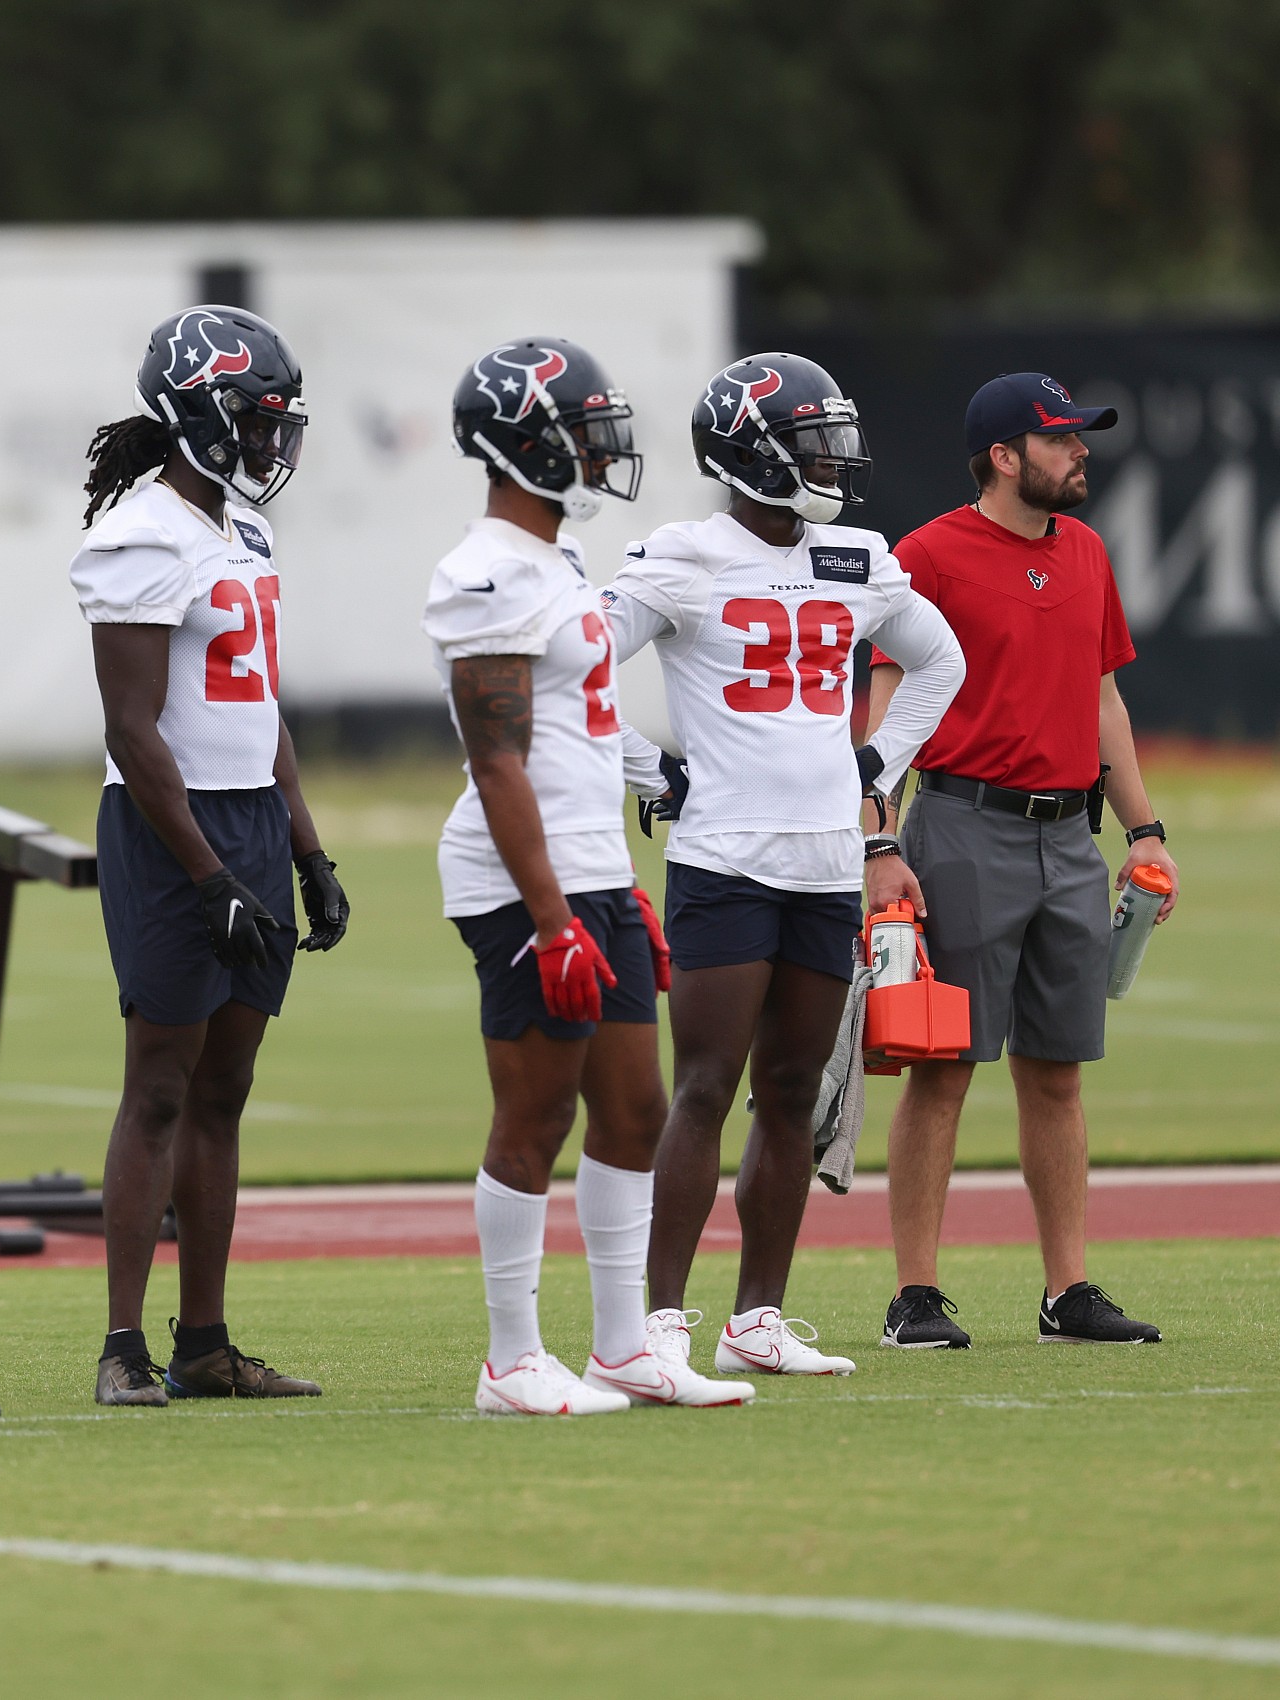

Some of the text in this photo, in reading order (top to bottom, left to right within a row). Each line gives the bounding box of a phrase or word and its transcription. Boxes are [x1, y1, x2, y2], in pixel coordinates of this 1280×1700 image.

[819, 557, 865, 570] Methodist
[581, 611, 621, 738] 2
[721, 597, 856, 716] 38
